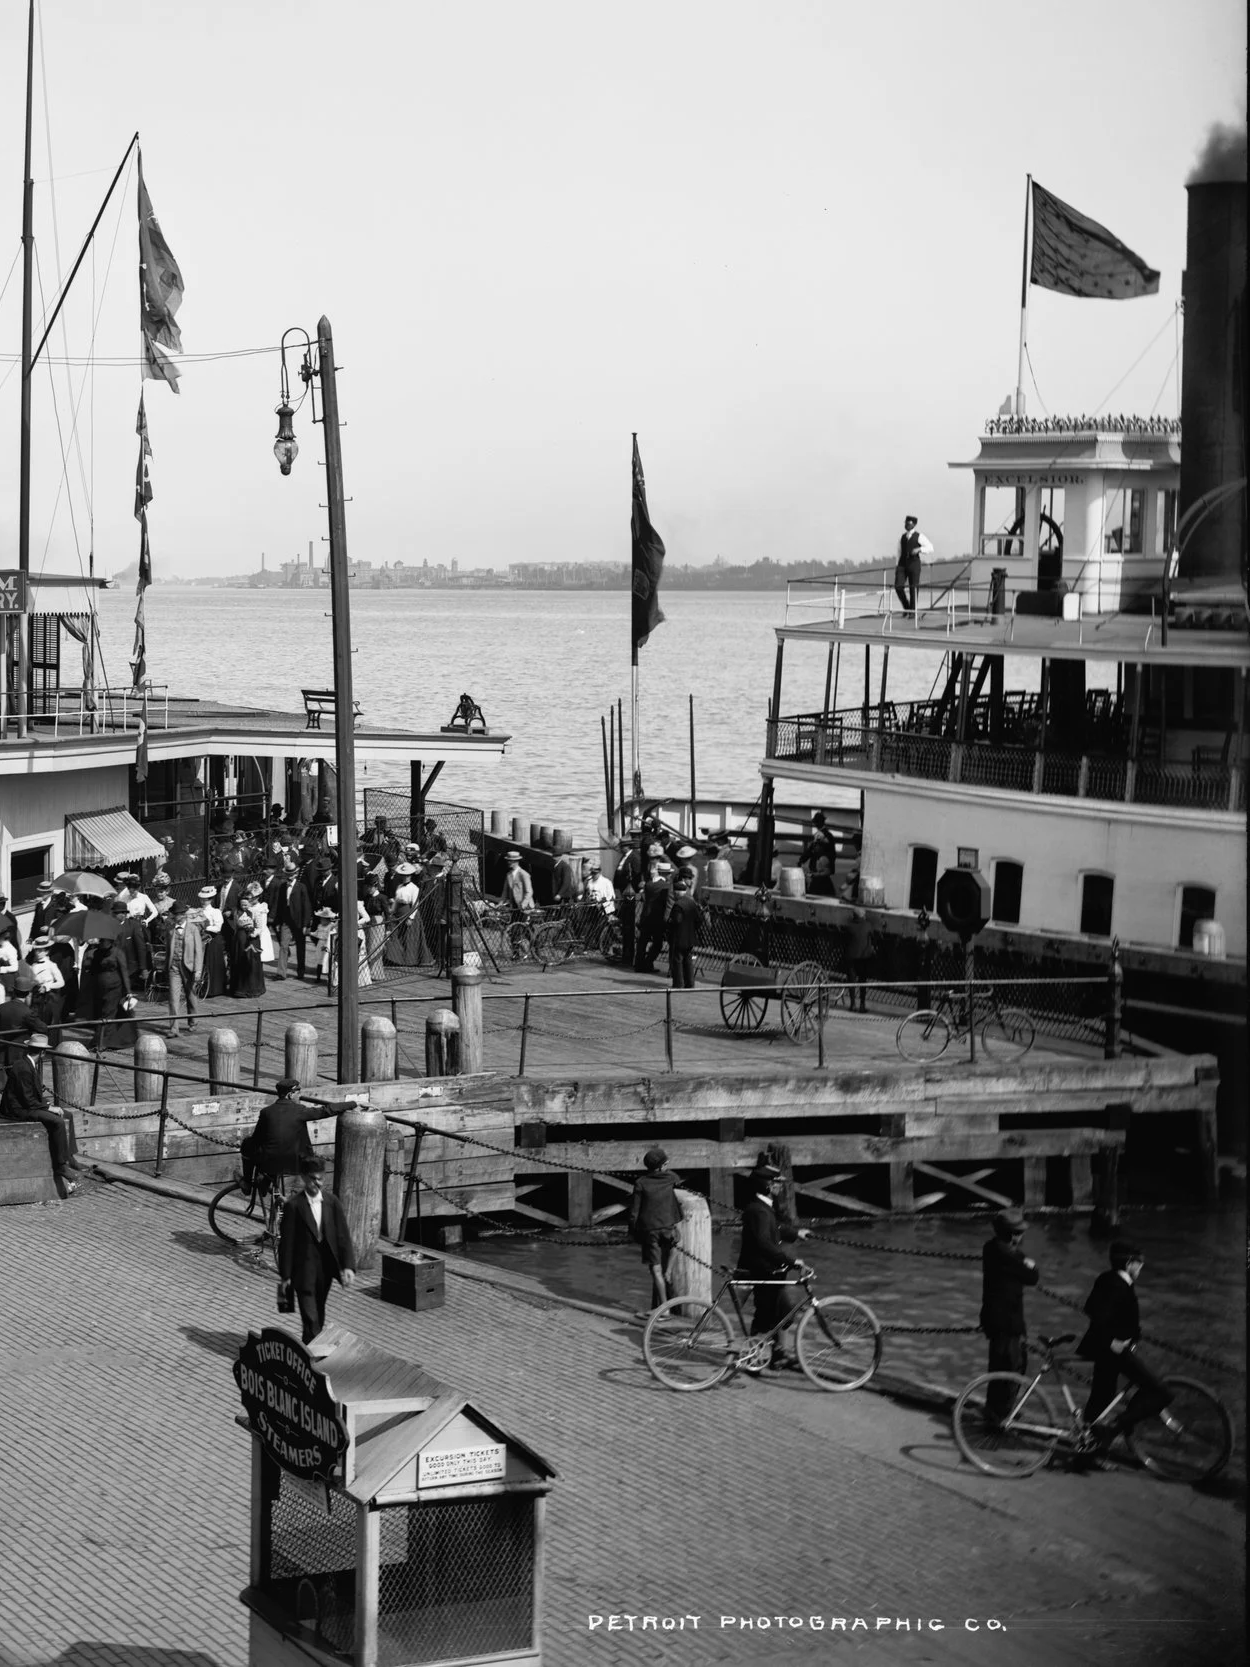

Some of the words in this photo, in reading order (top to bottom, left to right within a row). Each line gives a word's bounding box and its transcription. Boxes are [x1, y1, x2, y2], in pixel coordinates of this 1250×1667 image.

[256, 1341, 285, 1363] TICKET
[286, 1348, 317, 1394] OFFICE
[240, 1363, 266, 1402] BOIS
[267, 1379, 299, 1424] BLANC
[300, 1400, 338, 1448] ISLAND
[256, 1411, 322, 1468] STEAMERS
[425, 1453, 466, 1463] EXCURSION
[469, 1448, 500, 1457] TICKETS
